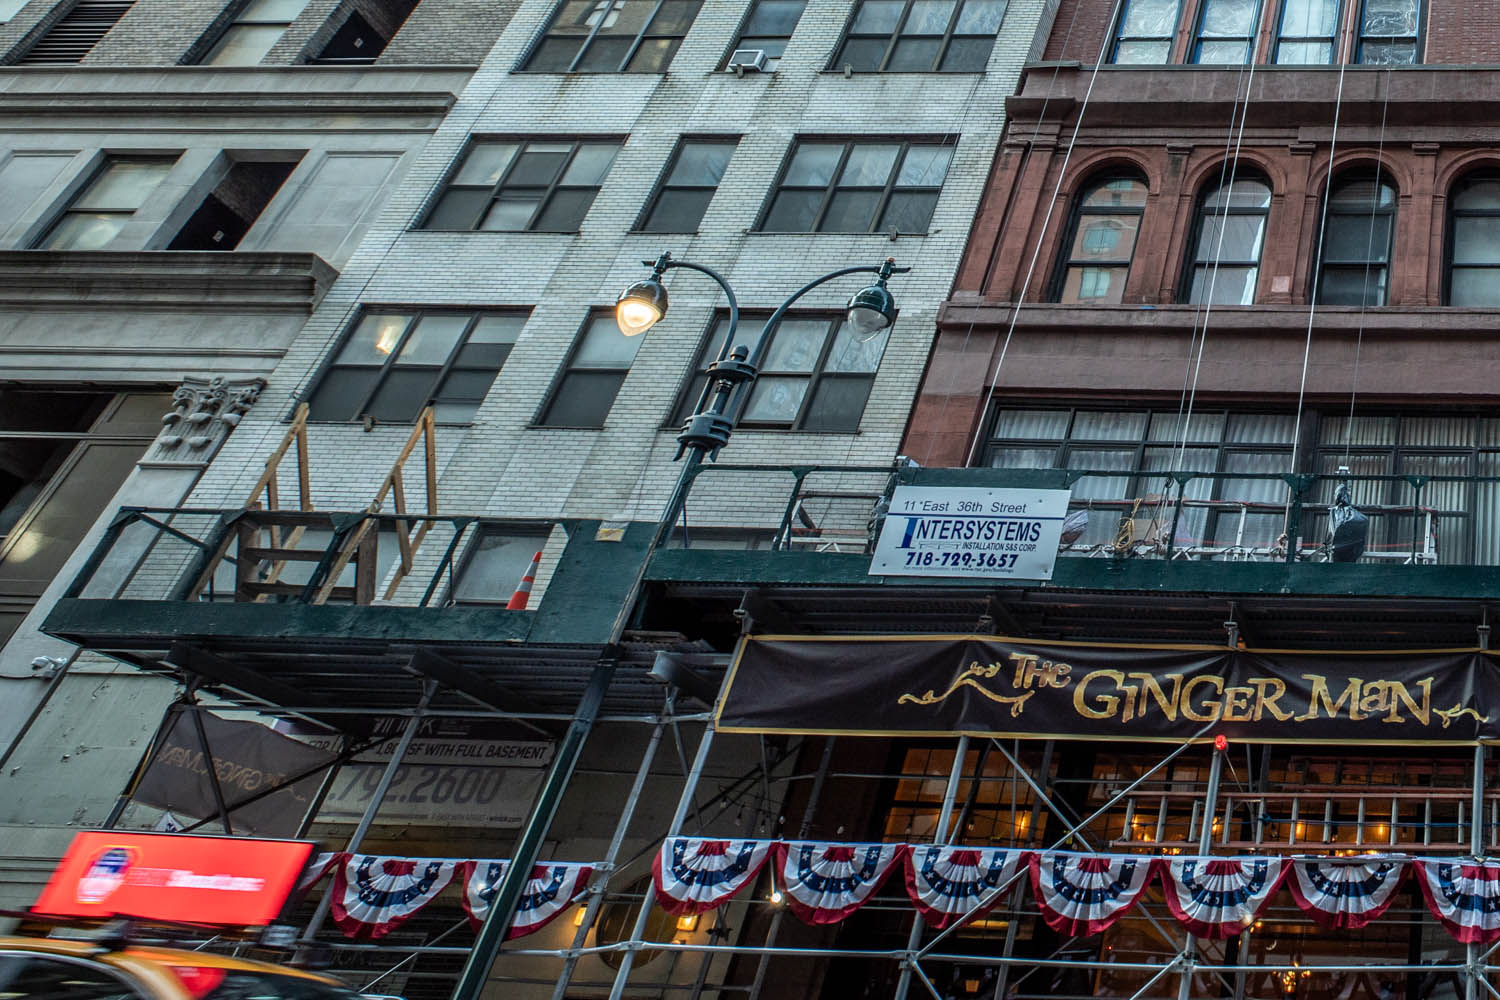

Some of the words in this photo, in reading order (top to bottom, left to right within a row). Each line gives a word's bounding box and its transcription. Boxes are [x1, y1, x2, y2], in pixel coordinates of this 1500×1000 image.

[904, 500, 916, 511] 11
[922, 501, 950, 512] East
[957, 501, 983, 513] 36th
[990, 502, 1027, 514] Street
[896, 517, 1042, 549] INTERSYSTEMS
[961, 541, 1004, 551] INSTALLATION
[905, 551, 1019, 568] 718-729-3657
[1073, 669, 1295, 723] GINGER
[424, 743, 456, 758] WITH
[455, 744, 484, 758] FULL
[485, 745, 548, 760] BASEMENT
